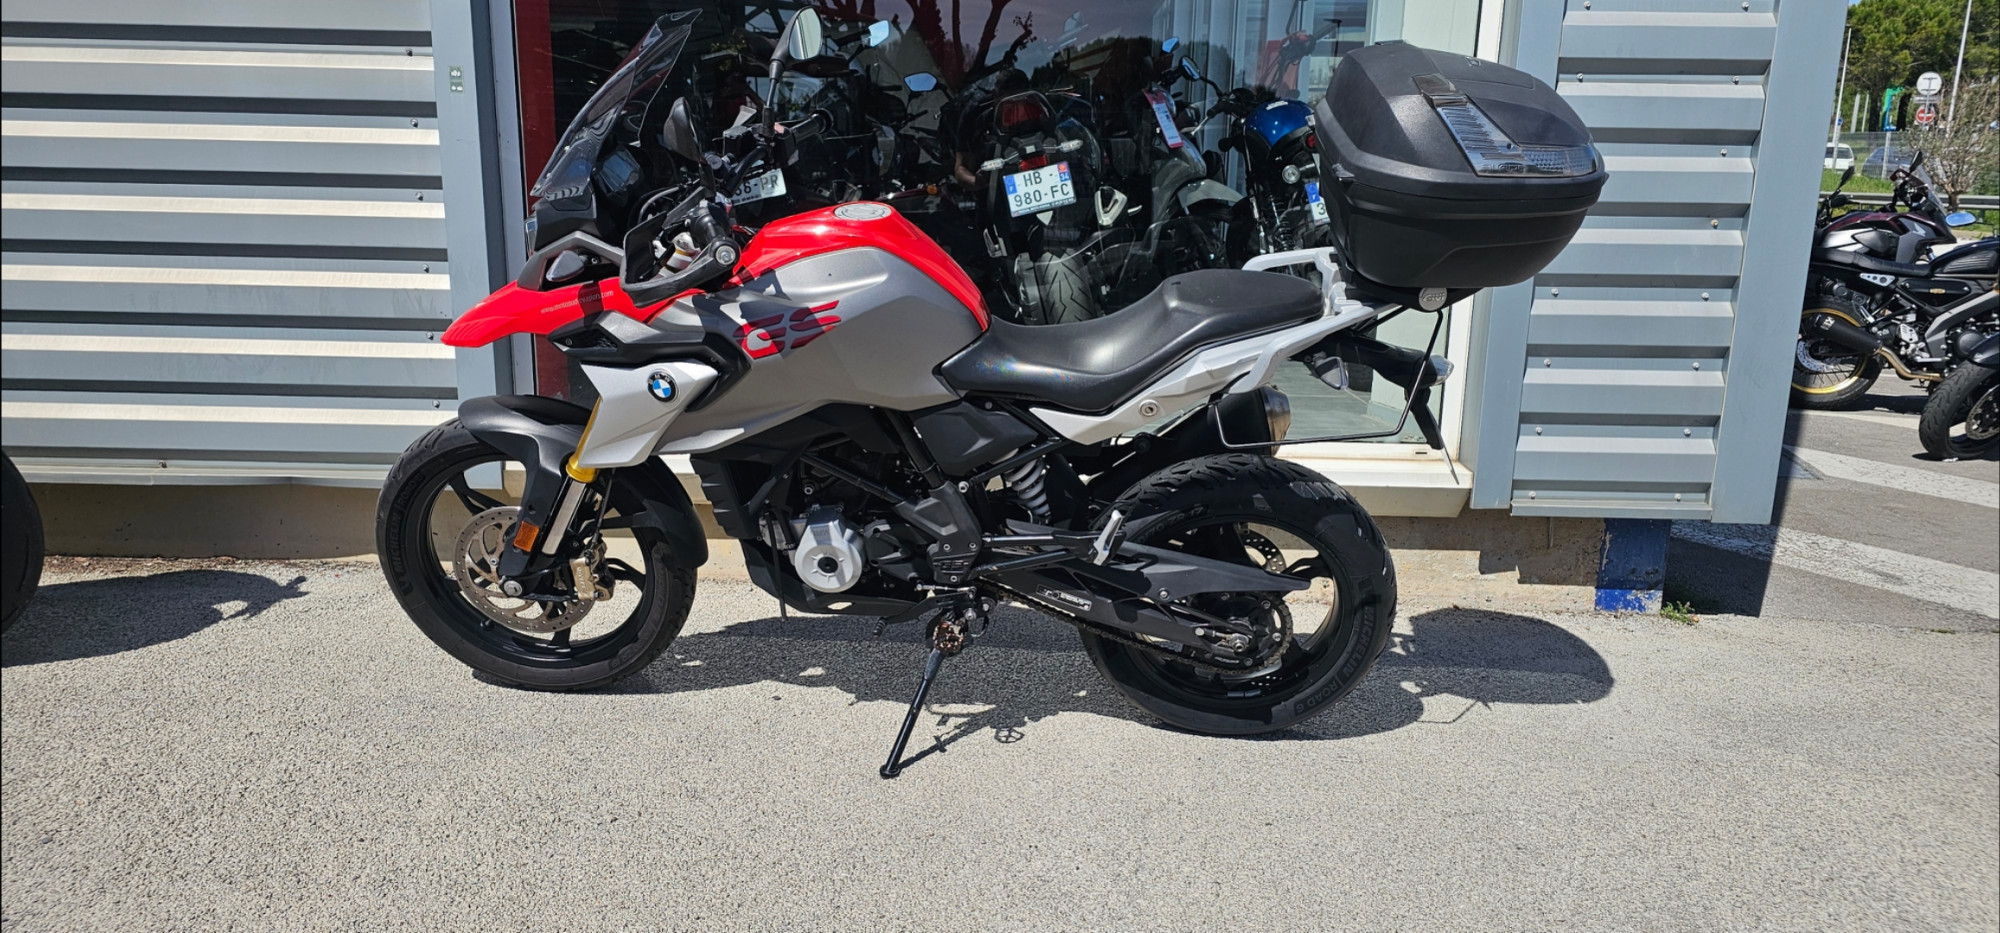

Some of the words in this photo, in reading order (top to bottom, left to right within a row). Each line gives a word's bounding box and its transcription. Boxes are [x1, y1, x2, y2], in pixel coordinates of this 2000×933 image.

[1023, 171, 1043, 187] HB
[1060, 172, 1070, 181] 34
[1013, 183, 1070, 207] 980-FC
[732, 299, 842, 360] GS
[389, 512, 405, 574] MICHELIN
[1341, 605, 1376, 678] MICHELIN
[1306, 680, 1338, 707] ROAD
